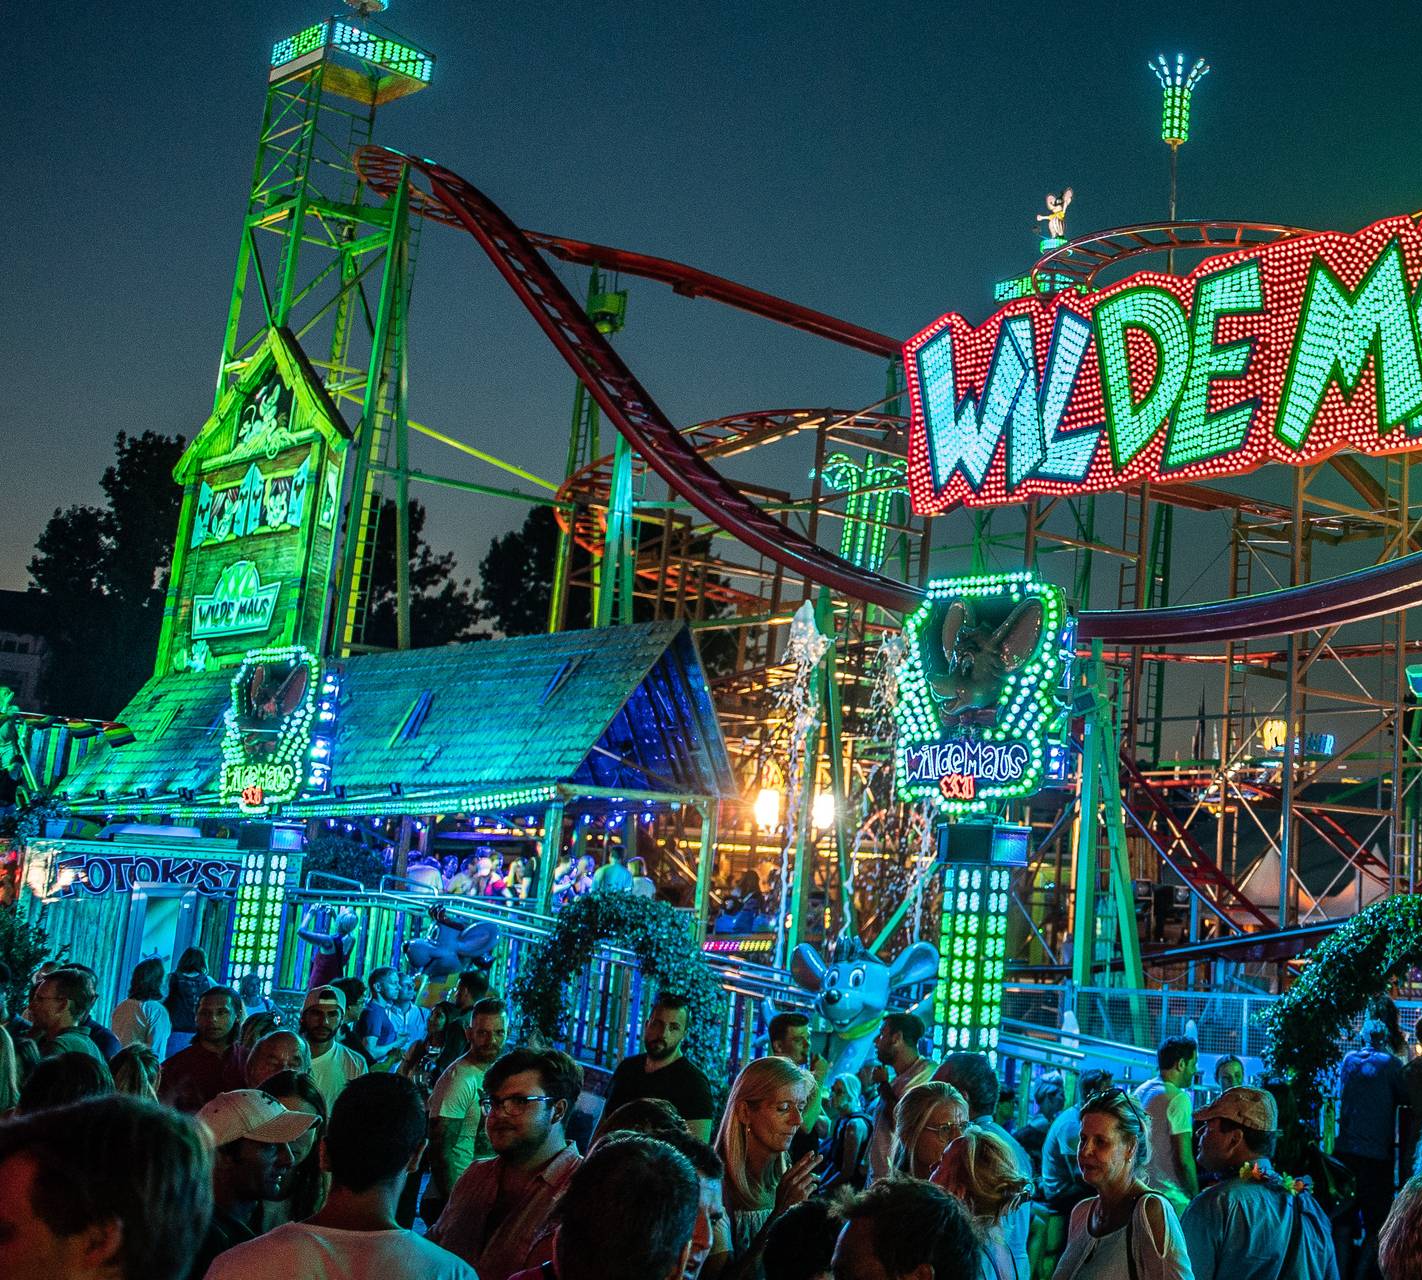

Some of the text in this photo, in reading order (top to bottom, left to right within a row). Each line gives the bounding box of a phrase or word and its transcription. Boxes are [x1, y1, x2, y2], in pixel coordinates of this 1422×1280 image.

[914, 256, 1265, 494] WILDE
[198, 597, 269, 628] WILDE MAUS
